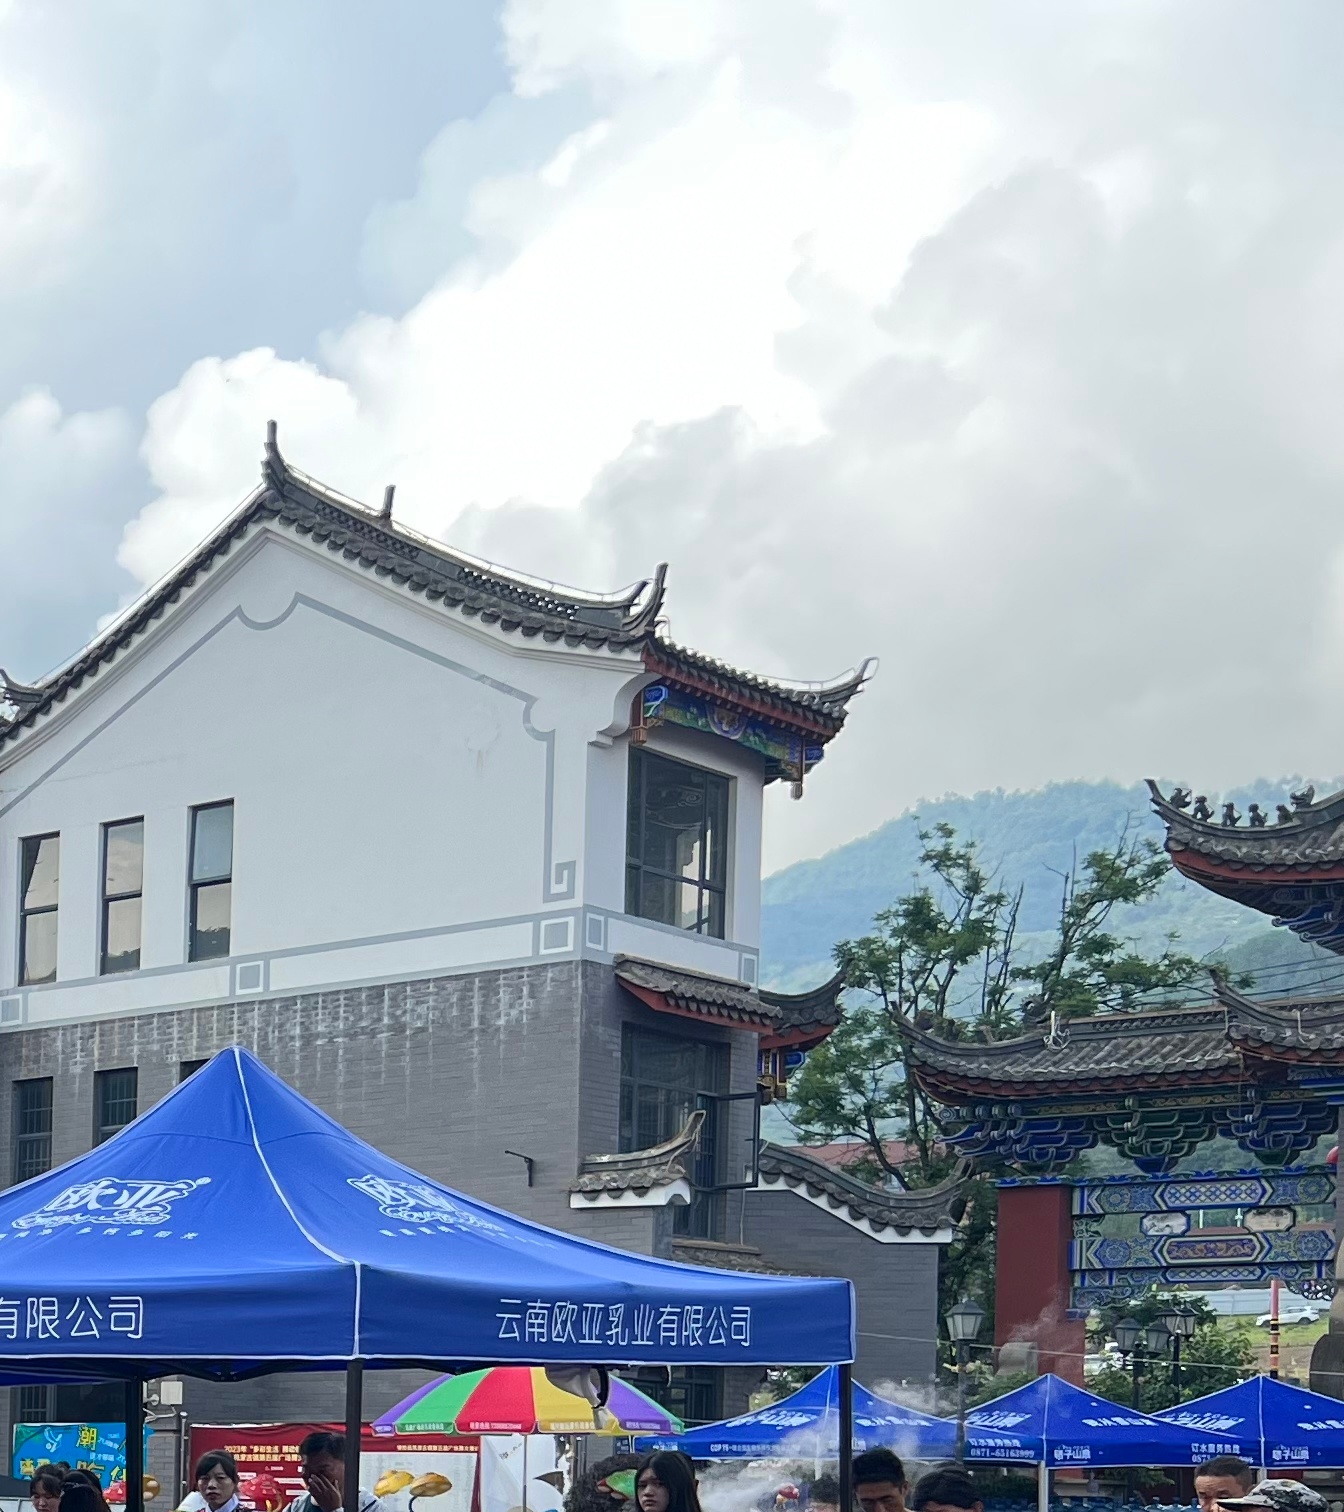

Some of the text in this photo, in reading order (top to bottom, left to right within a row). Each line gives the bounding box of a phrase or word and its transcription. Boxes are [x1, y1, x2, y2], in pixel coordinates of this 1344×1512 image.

[495, 1298, 751, 1347] 云南欧亚乳业有限公司
